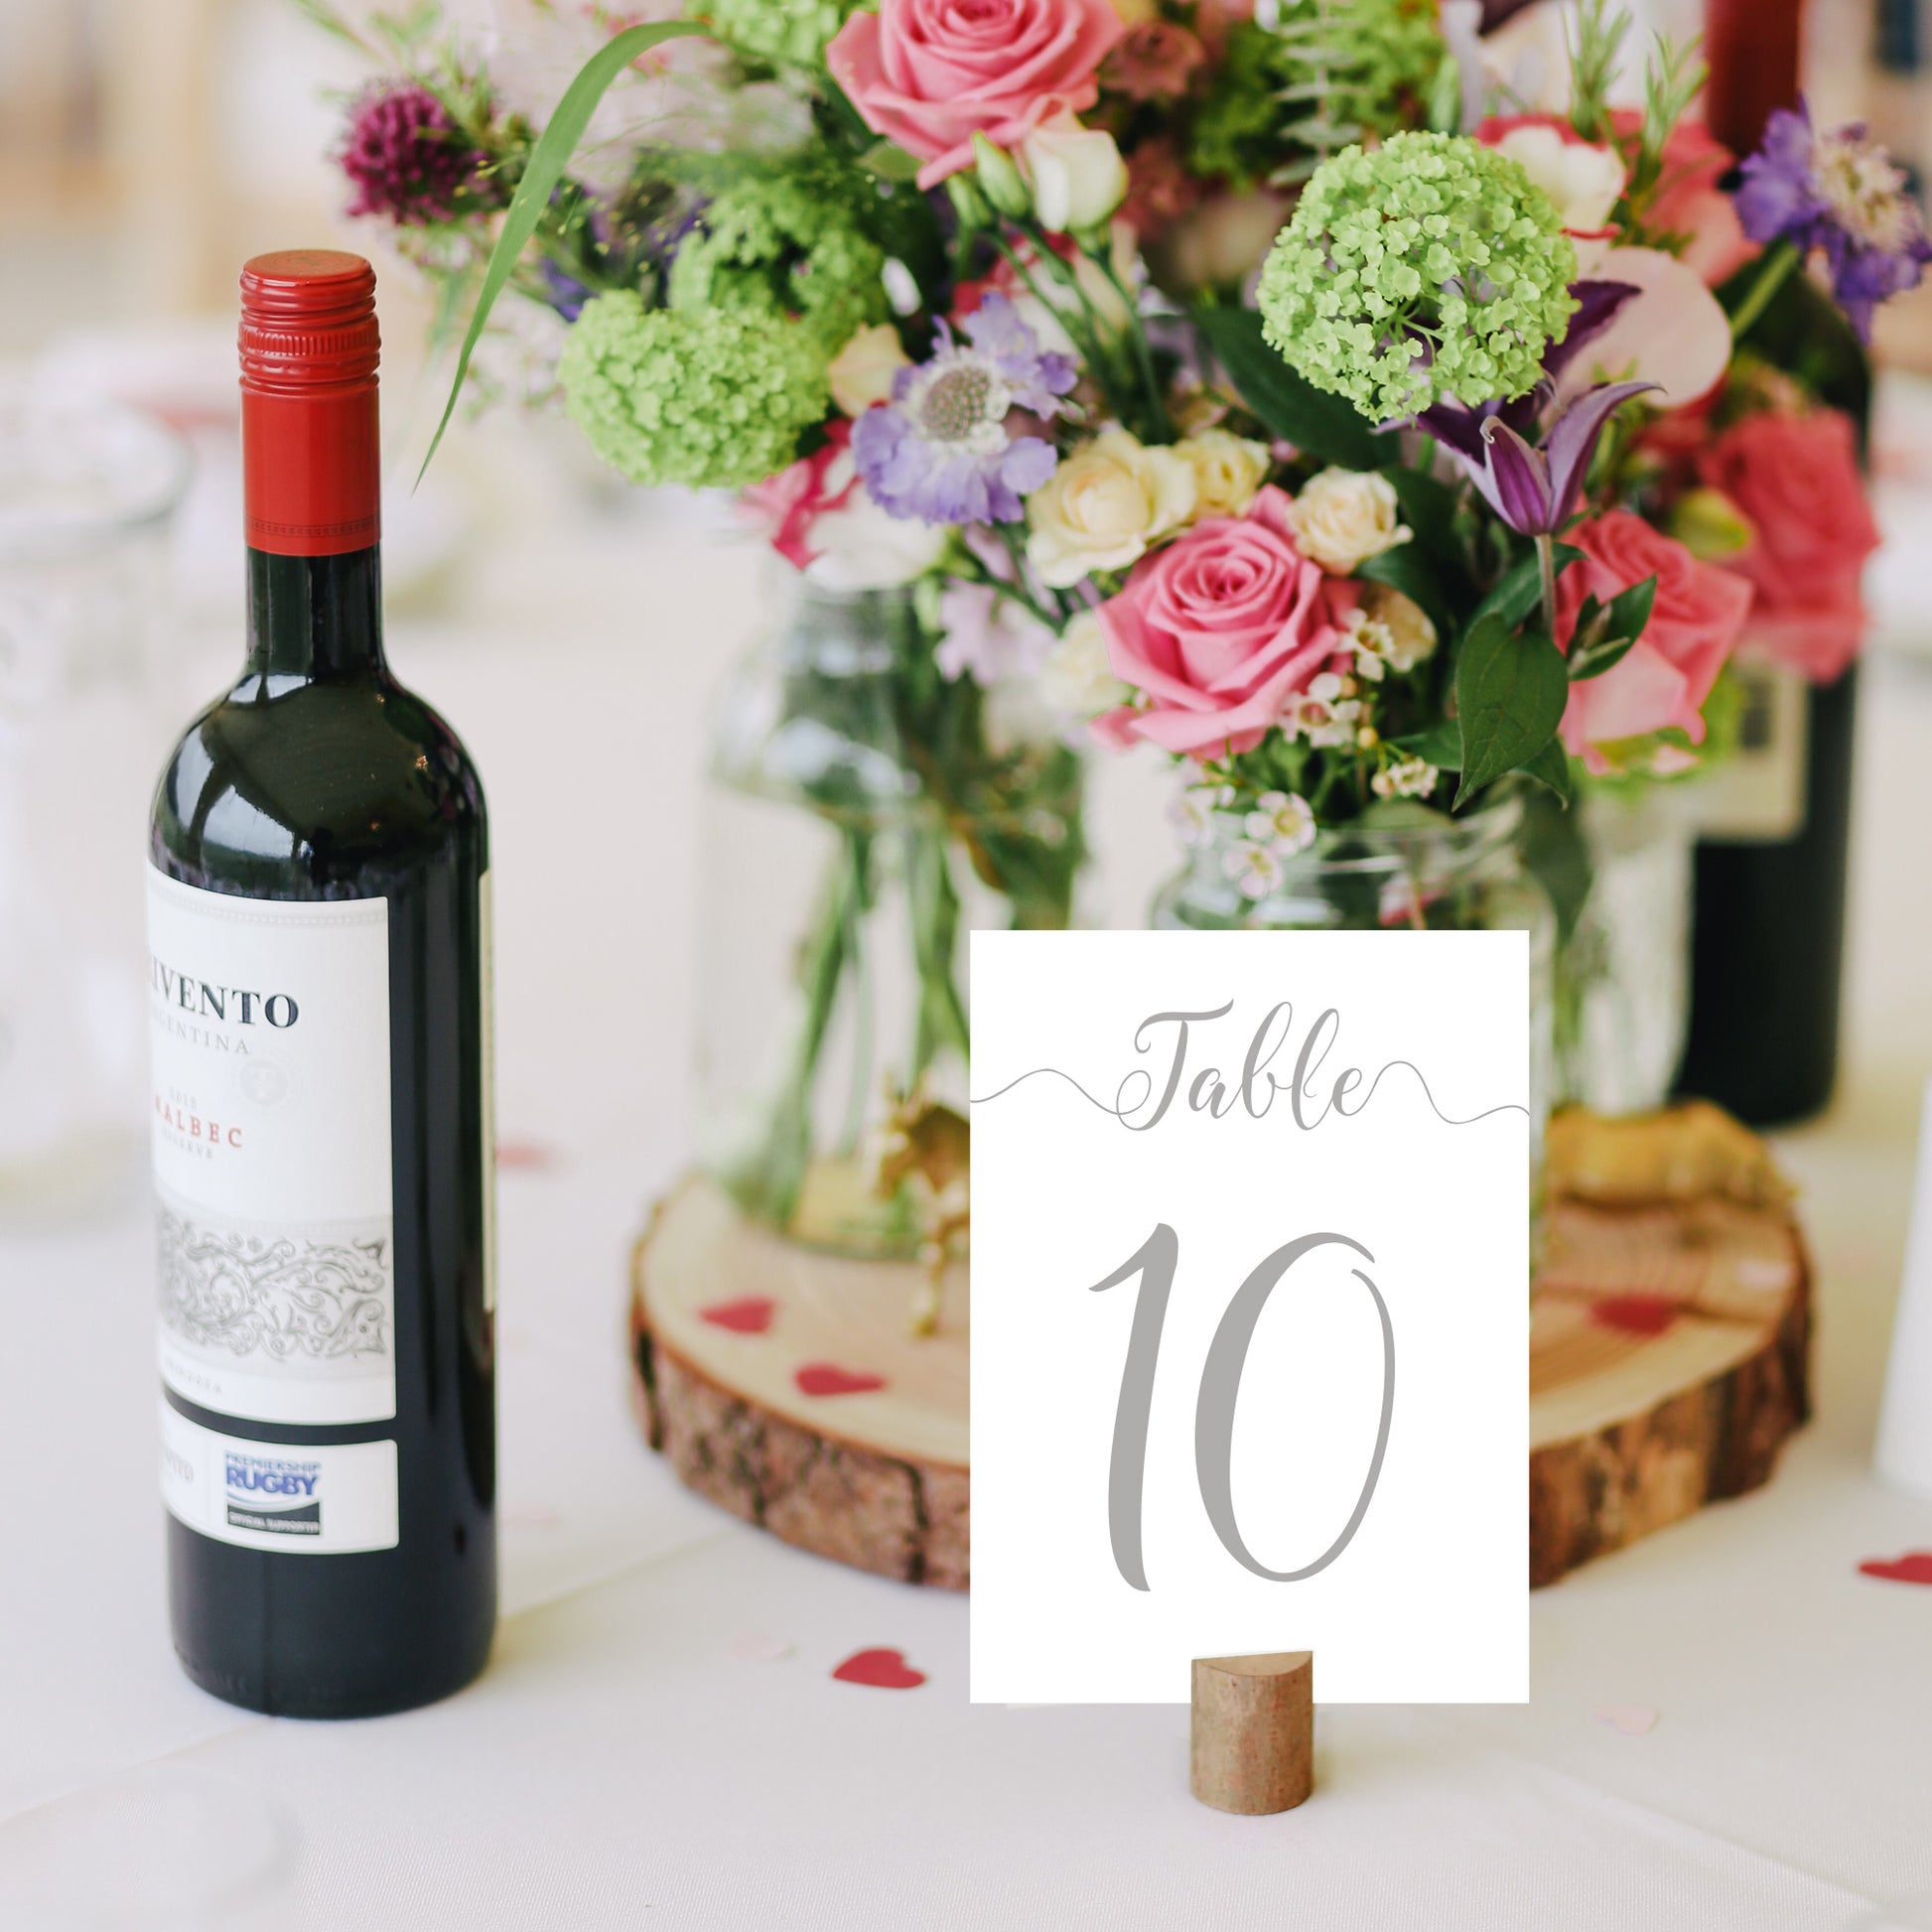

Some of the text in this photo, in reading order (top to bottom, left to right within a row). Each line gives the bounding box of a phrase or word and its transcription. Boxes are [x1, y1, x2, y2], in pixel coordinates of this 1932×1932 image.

[1110, 998, 1395, 1131] Table
[1088, 1222, 1396, 1592] 10
[226, 1465, 318, 1495] RUGBY
